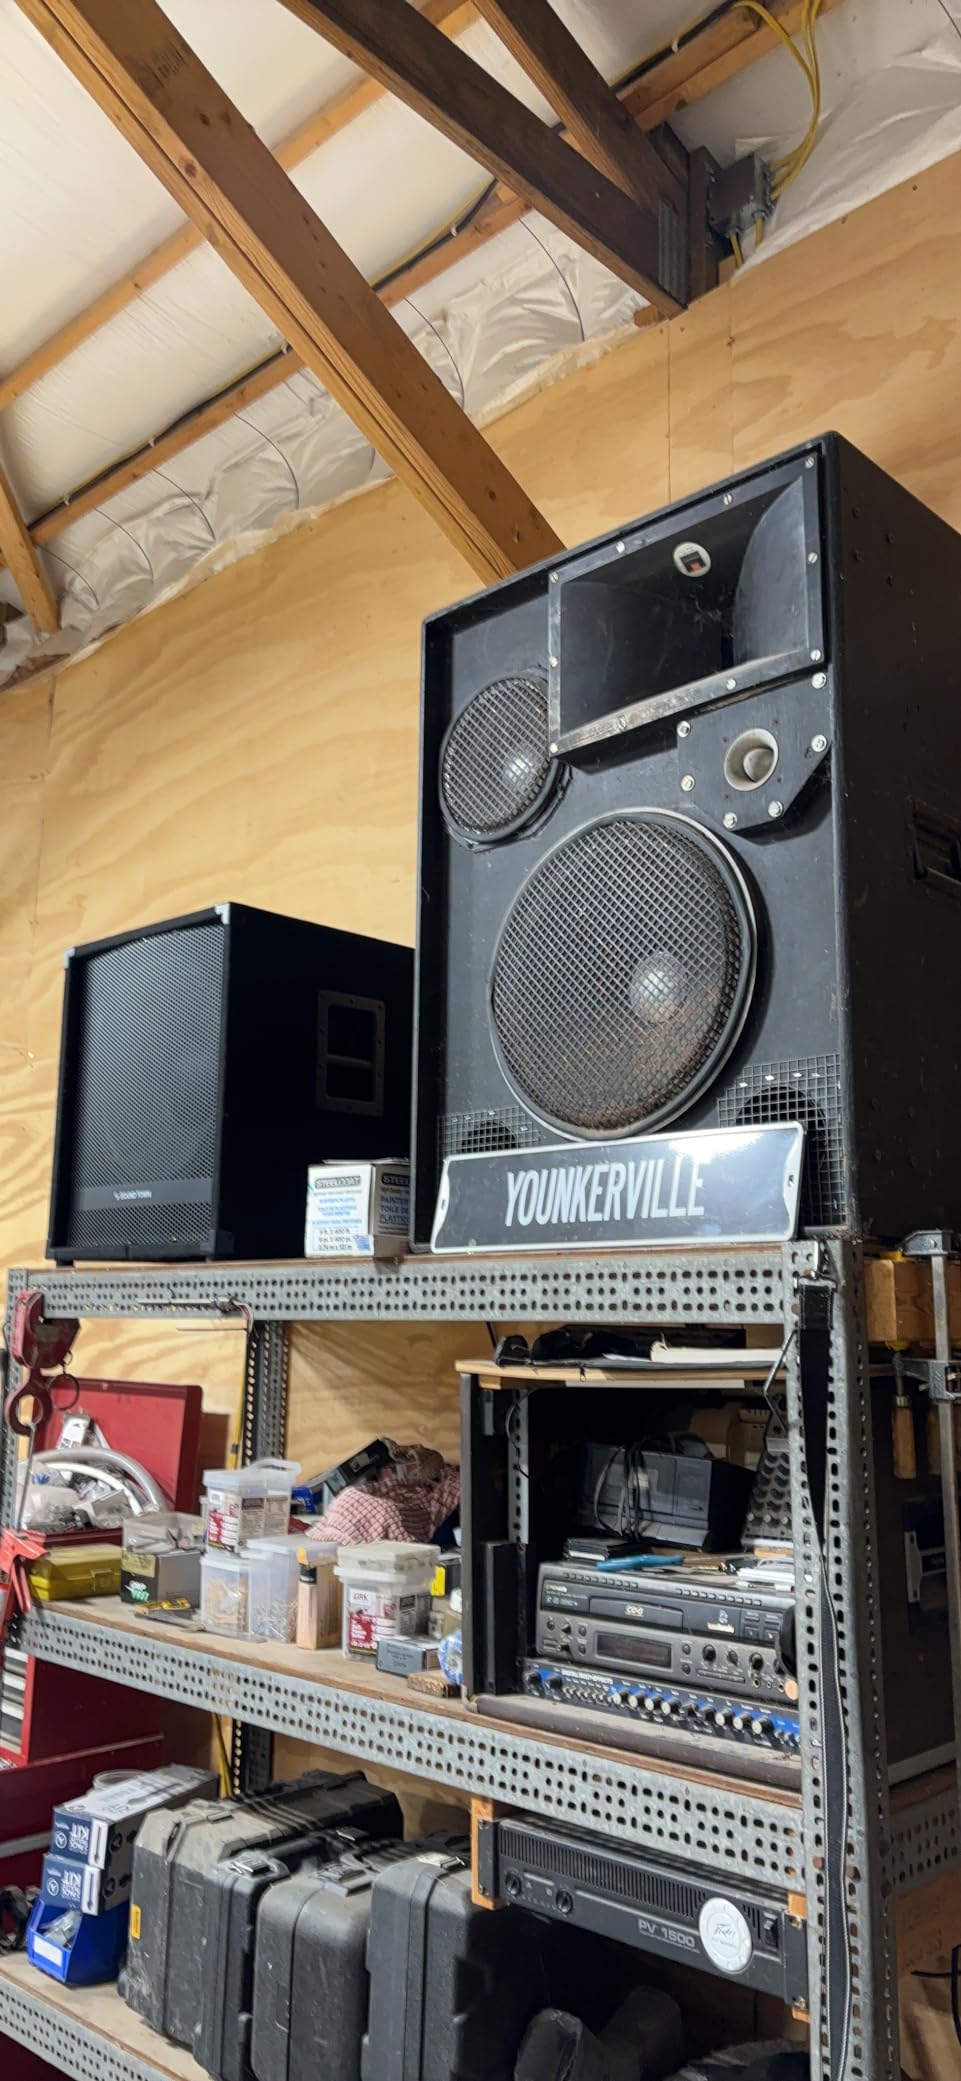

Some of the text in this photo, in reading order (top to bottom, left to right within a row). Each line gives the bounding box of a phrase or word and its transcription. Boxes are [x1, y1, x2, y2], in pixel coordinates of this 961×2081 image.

[505, 1155, 705, 1227] YOUNKERVILLE
[69, 1823, 90, 1841] KIT
[61, 1870, 82, 1886] KIT
[638, 1920, 657, 1934] PV
[661, 1926, 696, 1948] 1500
